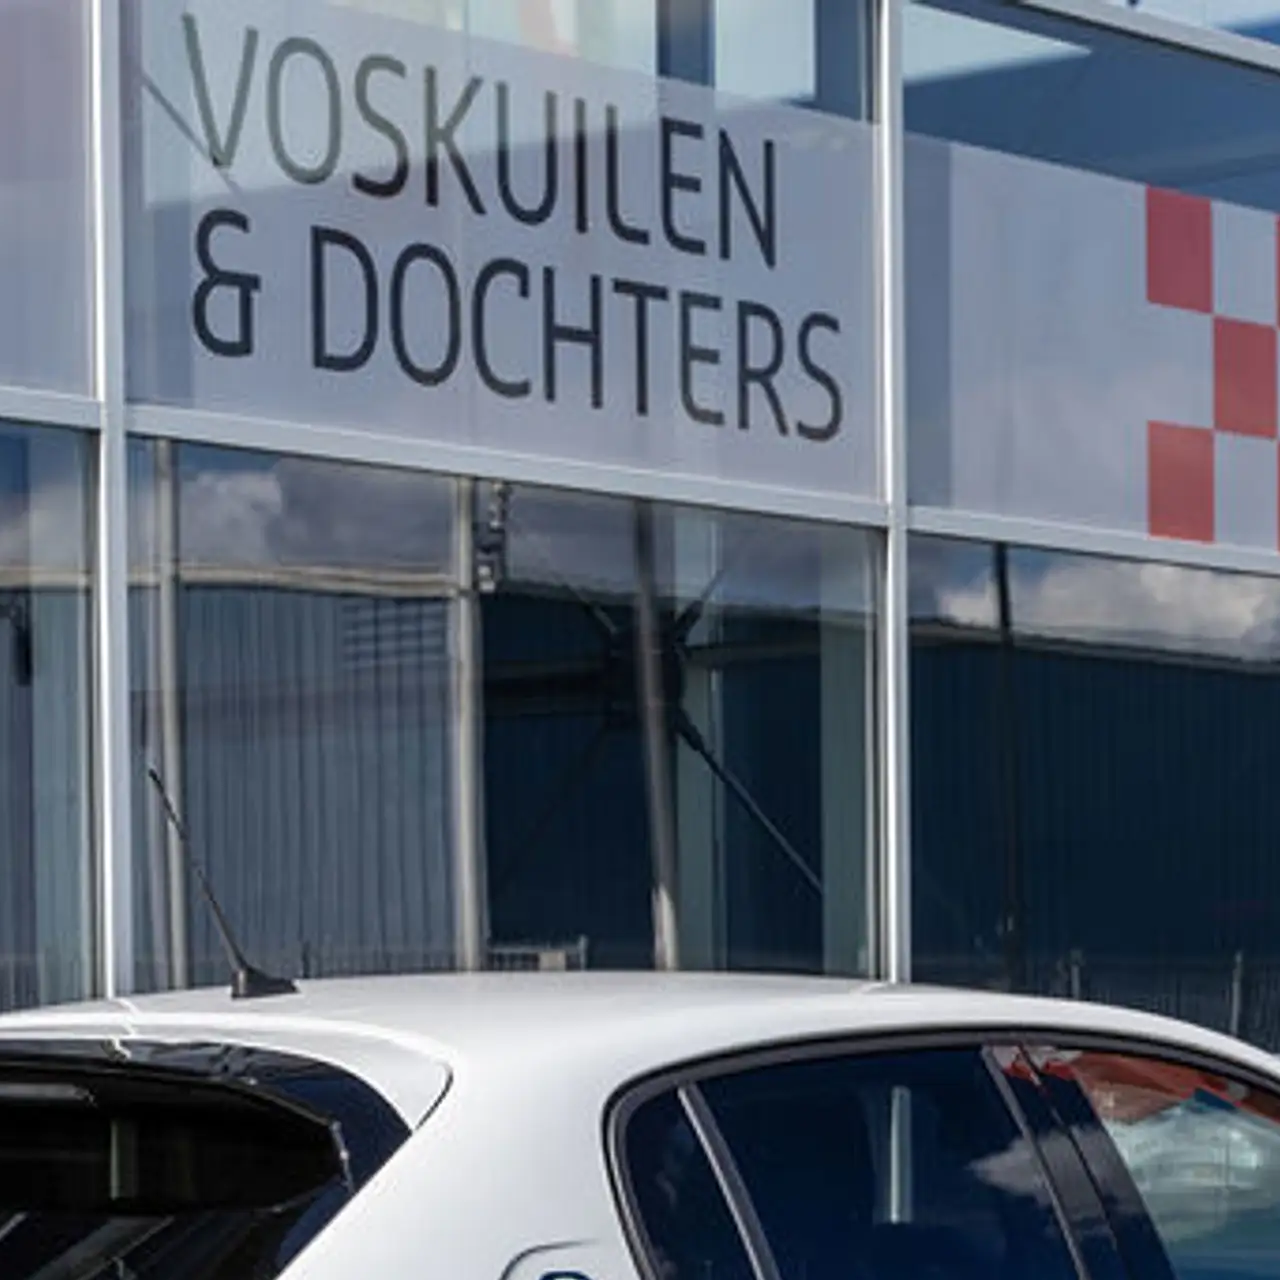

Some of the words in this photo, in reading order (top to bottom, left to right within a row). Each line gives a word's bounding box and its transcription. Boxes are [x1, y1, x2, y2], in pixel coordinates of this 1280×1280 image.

[182, 13, 777, 269] VOSKUILEN
[192, 209, 261, 358] &
[312, 223, 843, 442] DOCHTERS
